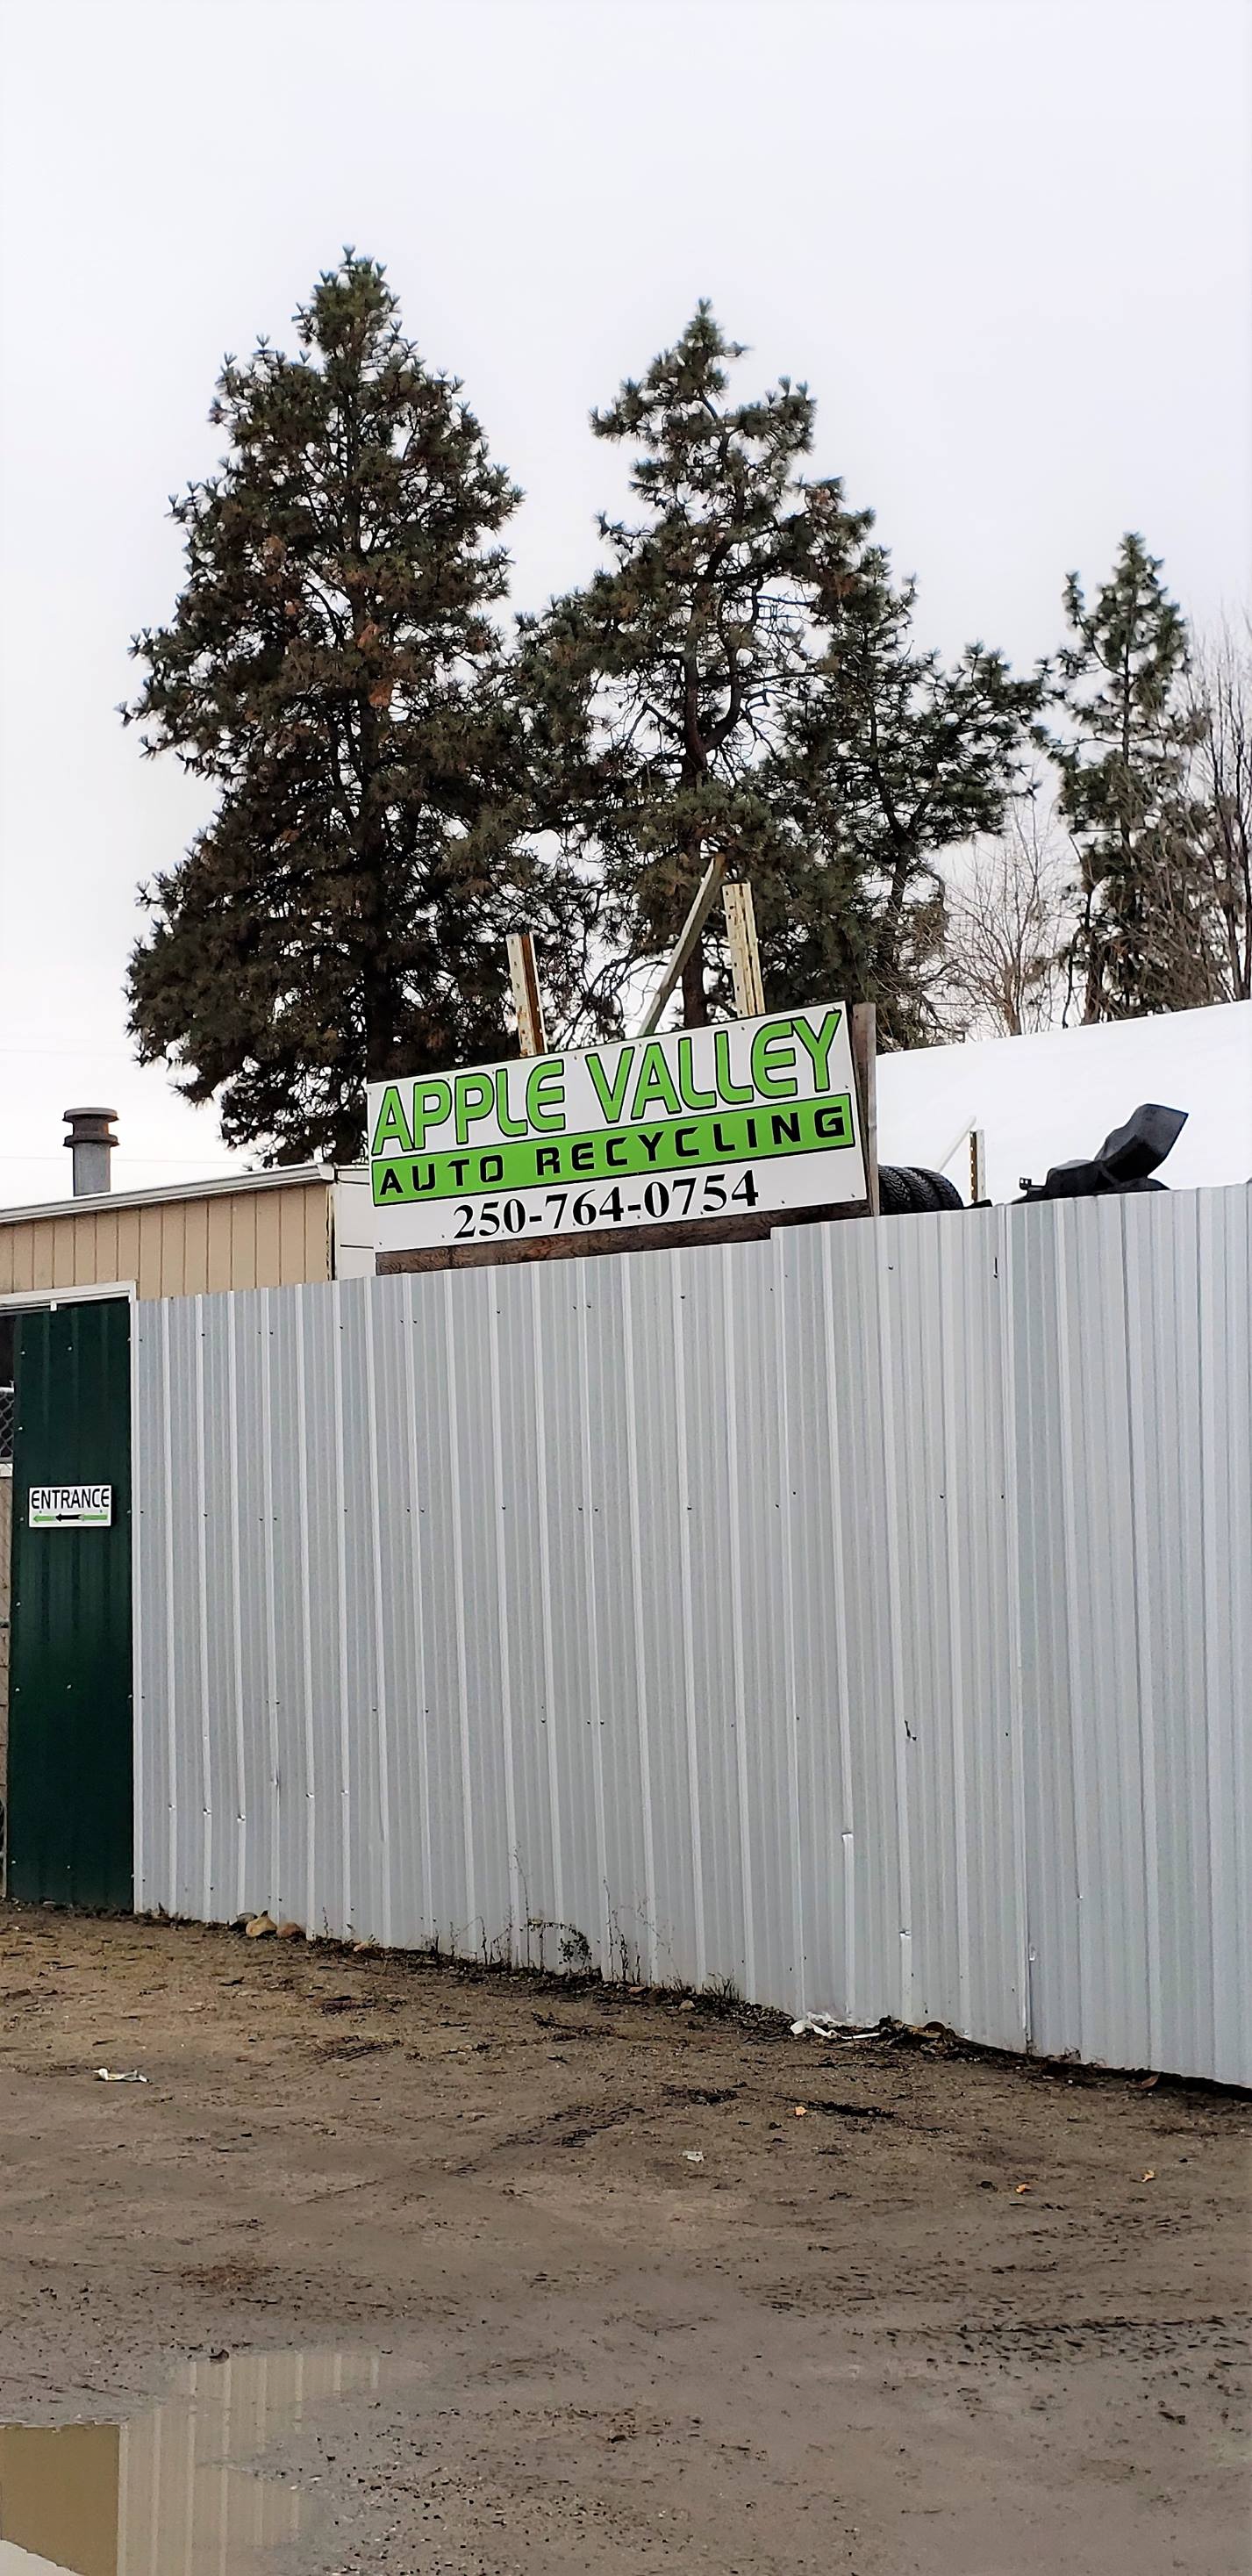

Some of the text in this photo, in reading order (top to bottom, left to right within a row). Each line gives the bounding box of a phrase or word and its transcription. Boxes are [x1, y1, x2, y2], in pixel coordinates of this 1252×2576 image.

[372, 1009, 841, 1155] APPLE VALLEY
[379, 1106, 844, 1195] AUTO RECYCLING
[453, 1169, 759, 1239] 250-764-0754
[31, 1488, 110, 1509] ENTRANCE
